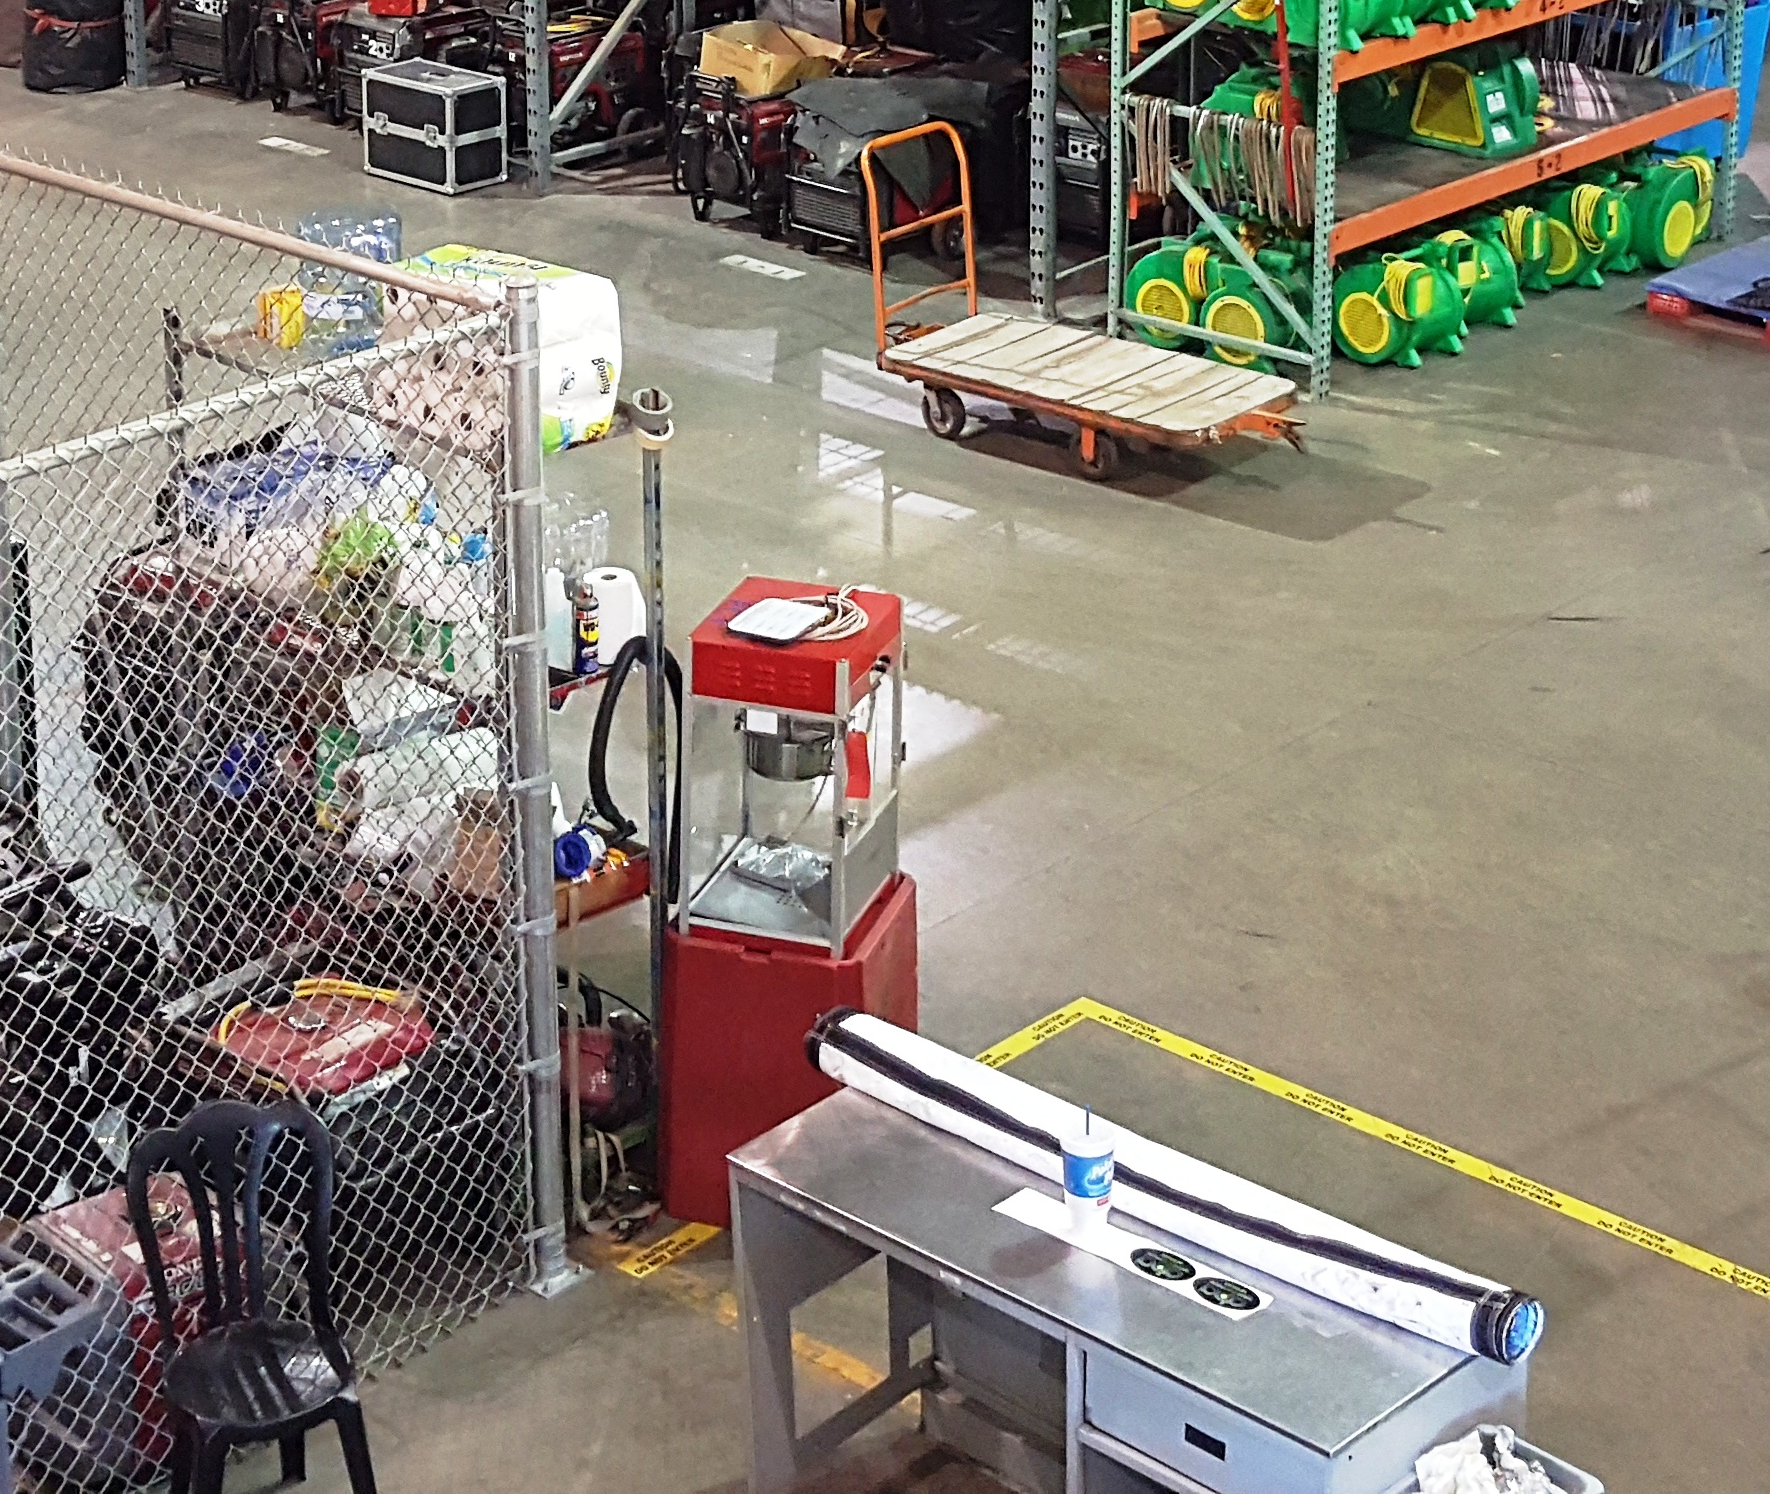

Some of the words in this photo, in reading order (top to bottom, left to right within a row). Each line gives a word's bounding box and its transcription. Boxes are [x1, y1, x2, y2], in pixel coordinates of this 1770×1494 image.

[591, 357, 611, 395] Bounty
[1205, 1059, 1224, 1068] NOT
[1225, 1068, 1255, 1081] ENTER
[1209, 1054, 1249, 1072] CAUTION
[1285, 1092, 1299, 1100] DO
[1302, 1099, 1320, 1108] NOT
[1322, 1108, 1353, 1122] ENTER
[1306, 1093, 1347, 1112] CAUTION
[1402, 1140, 1421, 1150] NOT
[1423, 1149, 1455, 1164] ENTER
[1406, 1134, 1448, 1154] CAUTION
[1506, 1183, 1526, 1193] NOT
[1529, 1192, 1562, 1208] ENTER
[1510, 1177, 1554, 1197] CAUTION
[1615, 1228, 1637, 1238] NOT
[1639, 1238, 1673, 1254] ENTER
[1619, 1222, 1665, 1242] CAUTION
[1710, 1267, 1726, 1276] DO
[1729, 1275, 1751, 1286] NOT
